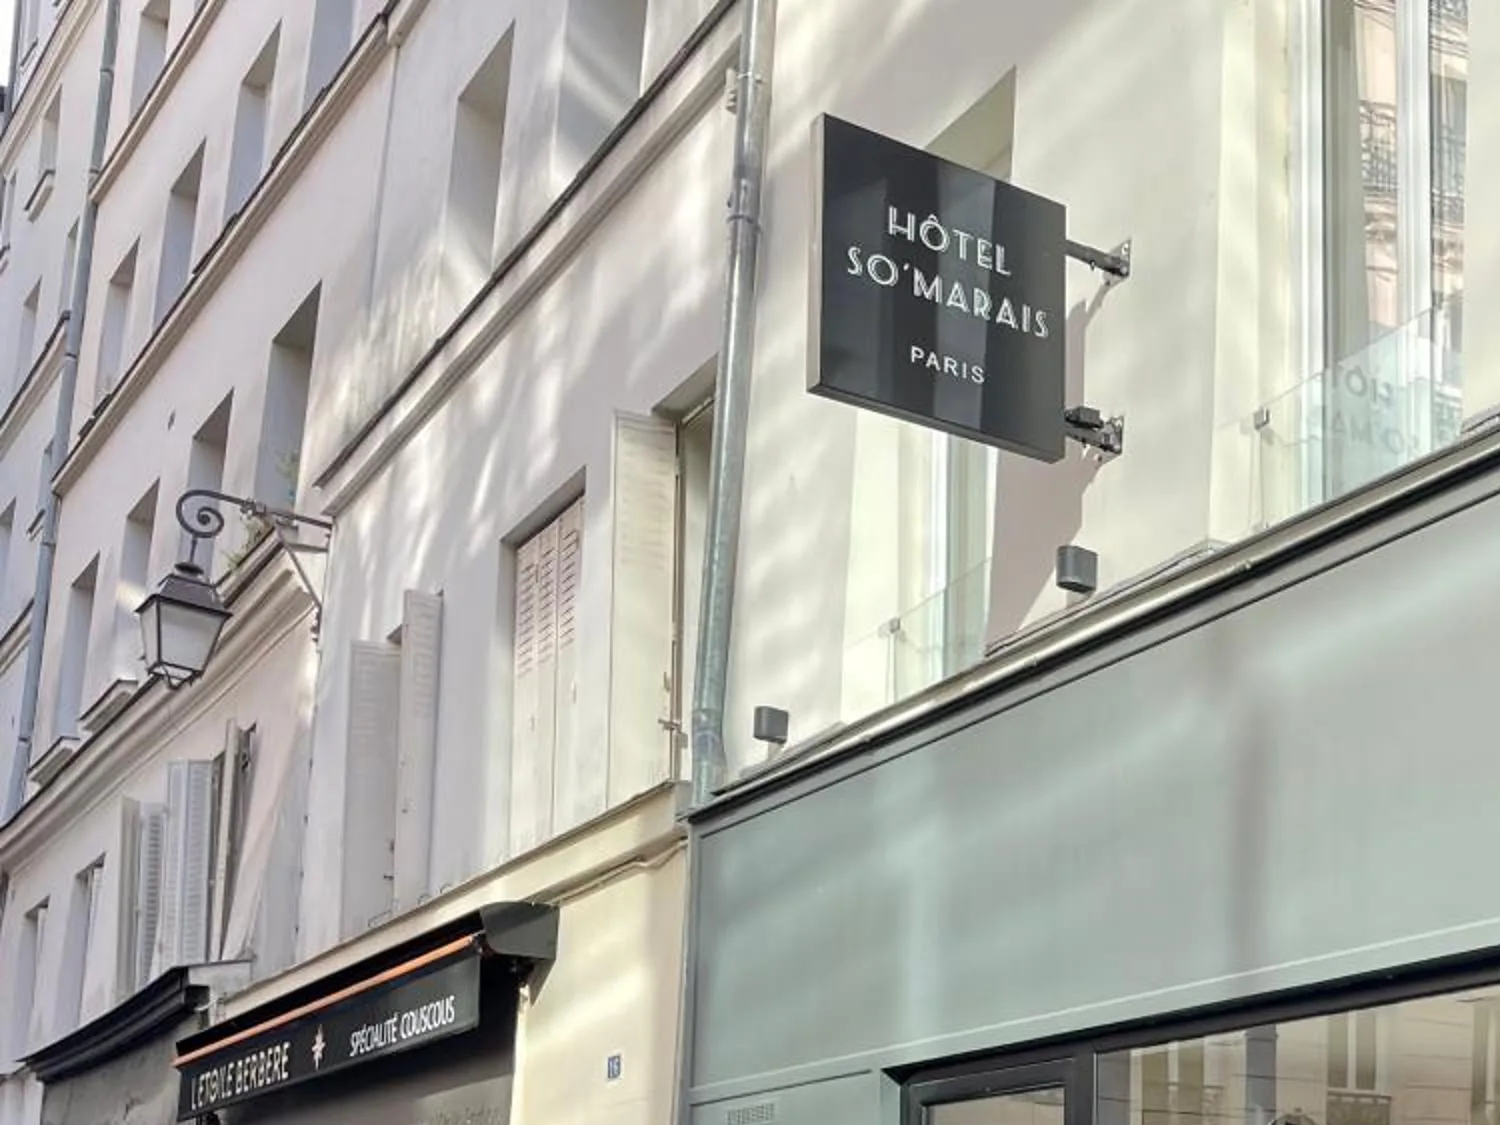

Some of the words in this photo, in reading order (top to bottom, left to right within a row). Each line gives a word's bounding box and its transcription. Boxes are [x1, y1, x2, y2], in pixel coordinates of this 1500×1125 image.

[887, 205, 1012, 276] HÔTEL
[847, 245, 1049, 339] SO'MARAIS
[910, 345, 986, 384] PARIS
[401, 994, 455, 1039] COUSCOUS
